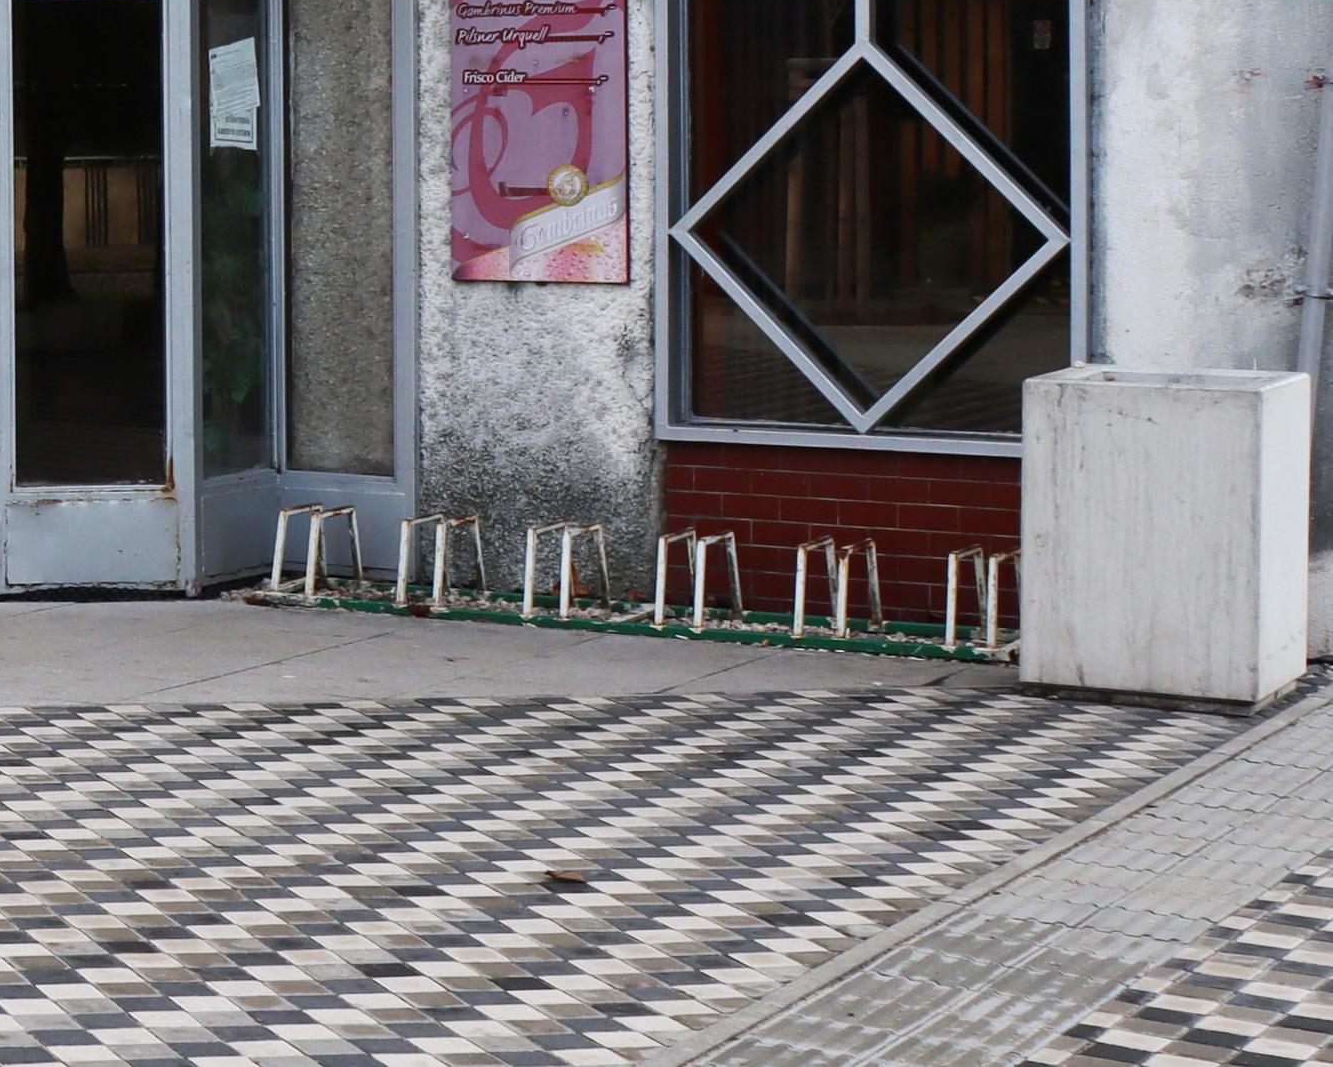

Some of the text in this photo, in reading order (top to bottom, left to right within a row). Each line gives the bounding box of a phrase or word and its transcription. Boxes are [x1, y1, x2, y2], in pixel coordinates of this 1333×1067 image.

[457, 2, 521, 17] Gambrinus
[524, 2, 576, 14] Premium
[457, 30, 499, 43] Pilsner
[502, 27, 549, 48] Urquell
[463, 71, 494, 83] Frisco
[496, 71, 526, 83] Cider
